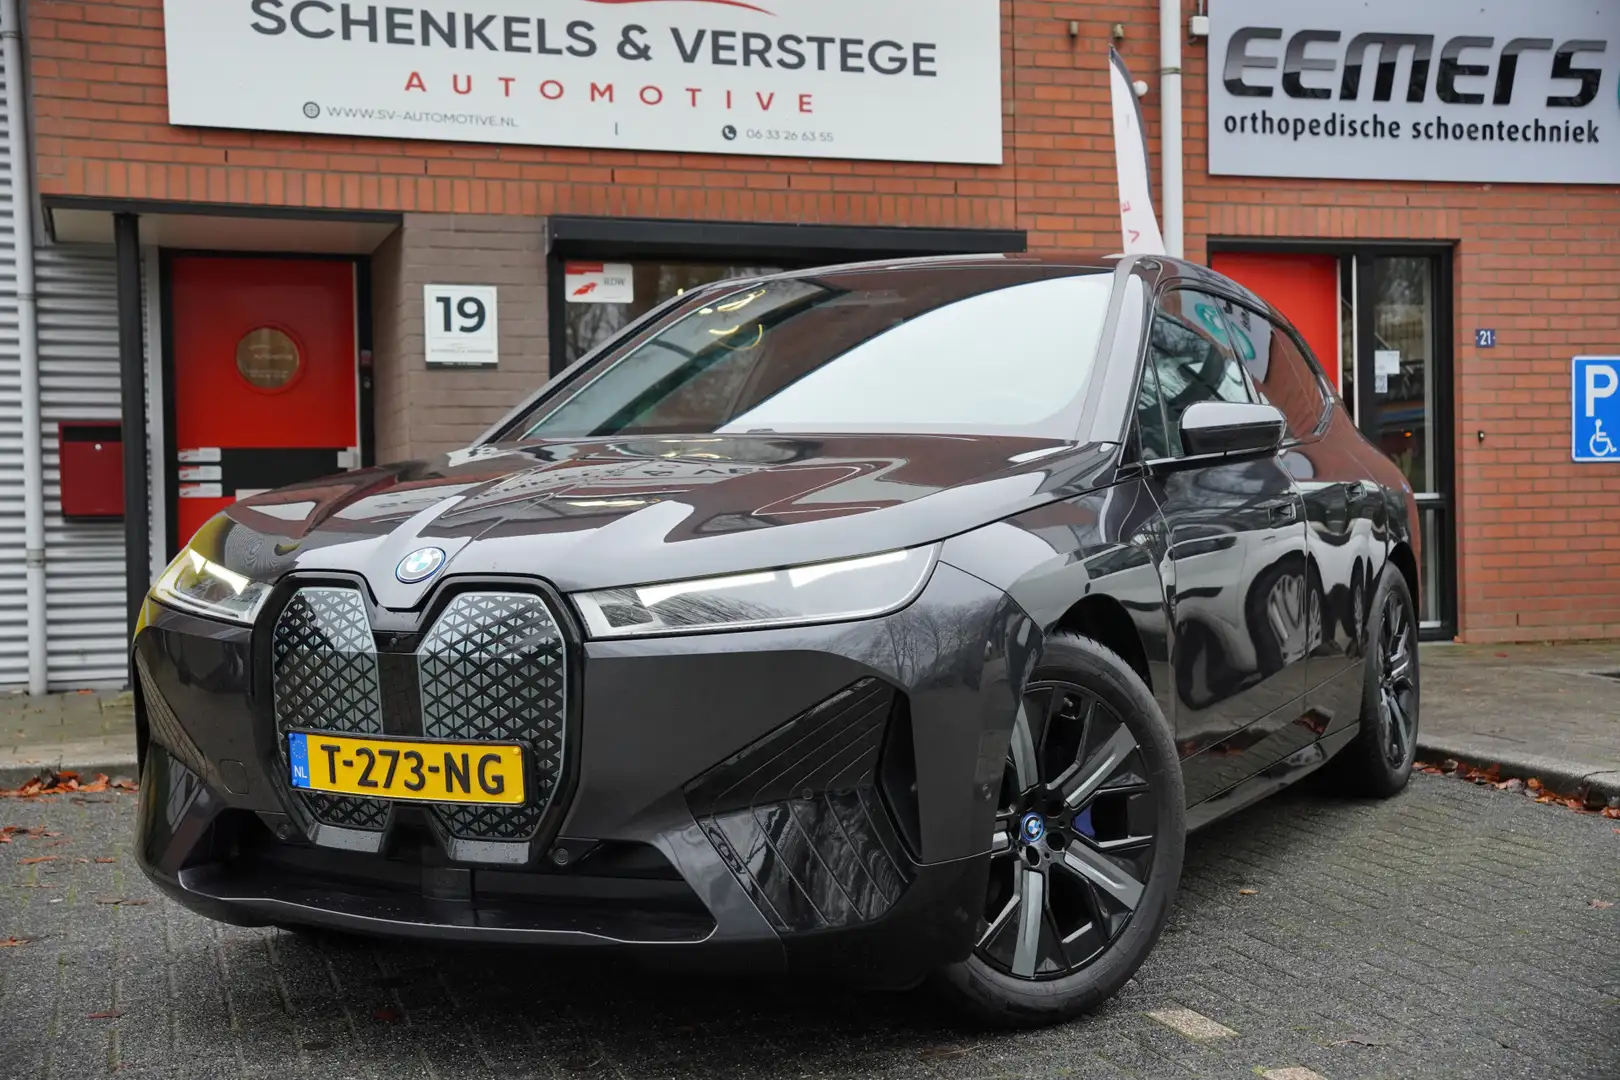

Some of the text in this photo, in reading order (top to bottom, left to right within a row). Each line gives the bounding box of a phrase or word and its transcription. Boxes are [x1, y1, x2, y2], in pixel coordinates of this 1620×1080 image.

[250, 0, 938, 77] SCHENKELS & VERSTEGE
[404, 71, 814, 114] AUTOMOTIVE
[326, 105, 519, 128] WWW.SV-AUTOMOTIVE.NL
[1224, 111, 1600, 144] orthopedische schoentechniek
[746, 128, 834, 143] 06 33 26 63 55
[435, 295, 486, 333] 19
[1479, 330, 1492, 346] 21
[1585, 364, 1619, 418] P
[293, 764, 308, 780] NL
[320, 743, 505, 796] T-273-NG
